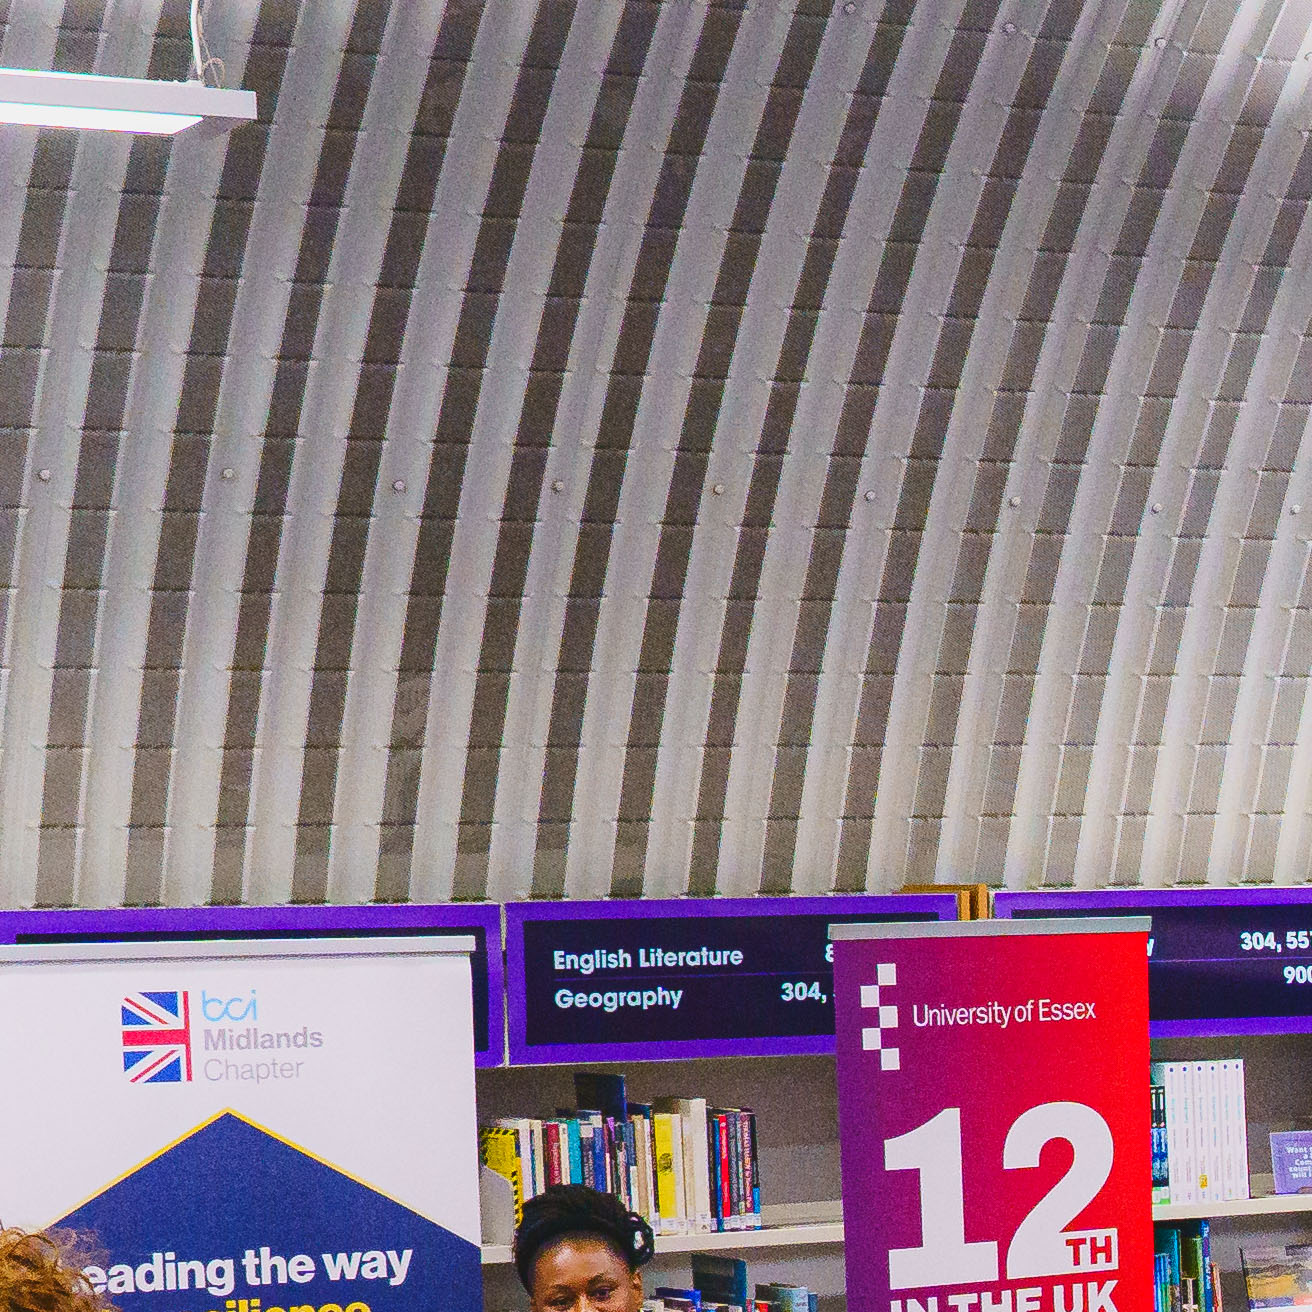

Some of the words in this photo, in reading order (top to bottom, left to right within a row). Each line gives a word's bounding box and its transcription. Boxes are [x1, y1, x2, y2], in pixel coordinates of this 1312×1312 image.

[1240, 931, 1282, 952] 304,
[553, 948, 631, 974] English
[639, 947, 744, 969] Literature
[555, 986, 683, 1012] Geography
[912, 1001, 1011, 1029] University
[1014, 1000, 1034, 1022] of
[1038, 998, 1096, 1022] Essex
[204, 1027, 324, 1050] Midlands
[204, 1058, 304, 1083] Chapter
[884, 1100, 1118, 1290] 12
[1065, 1235, 1112, 1266] TH
[83, 1252, 234, 1297] eading
[242, 1246, 315, 1284] the
[322, 1249, 413, 1286] way
